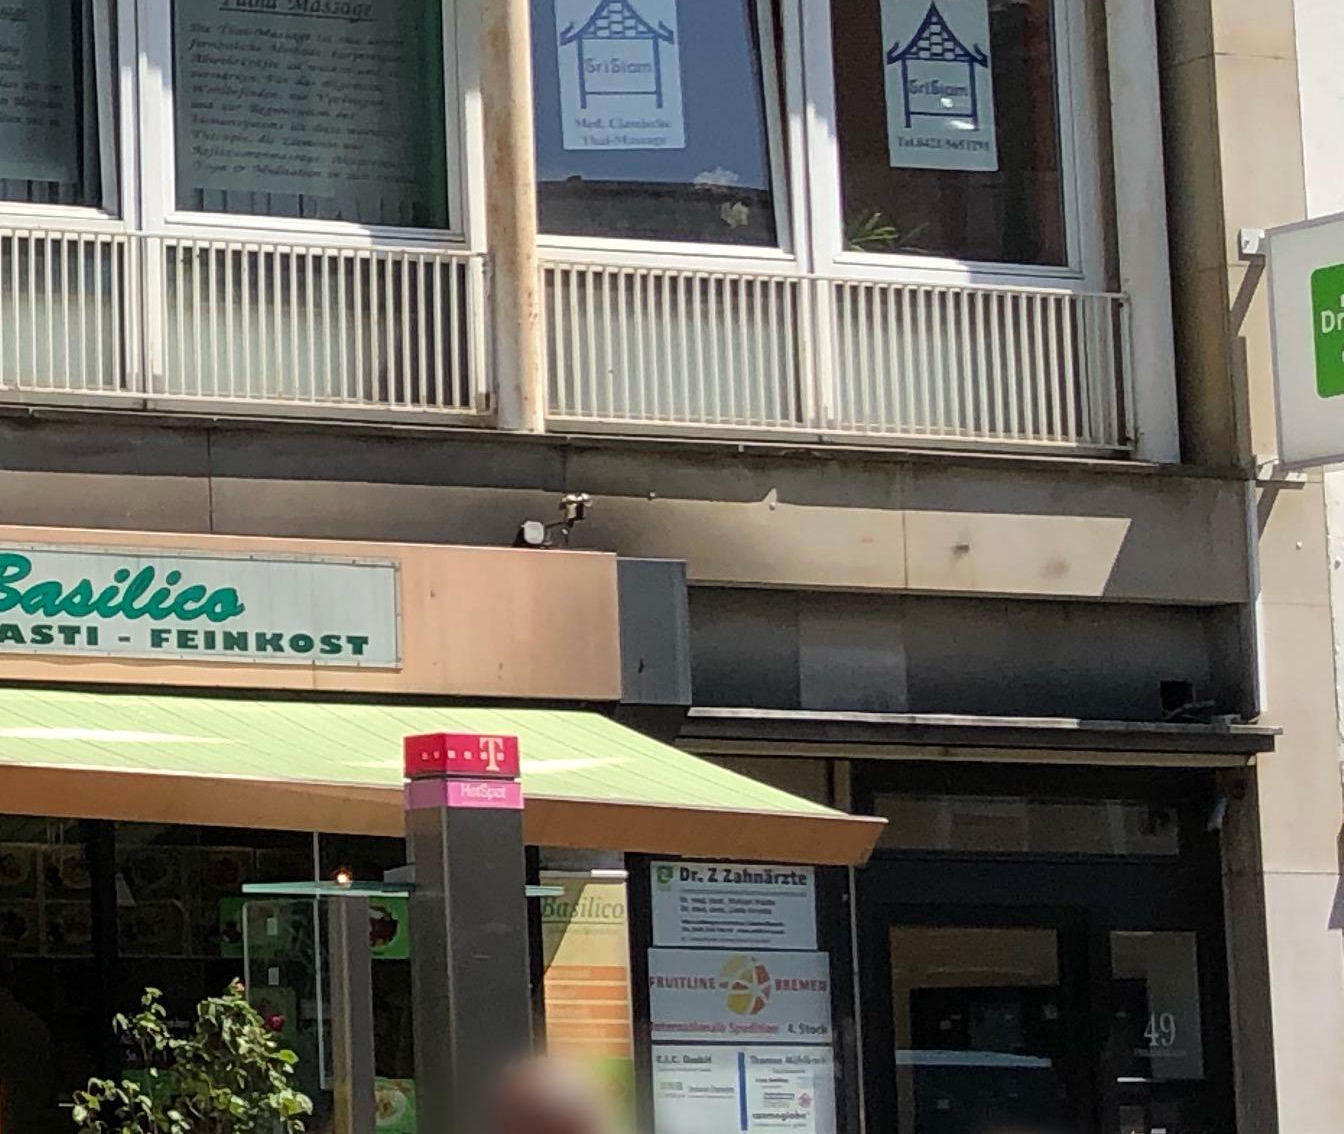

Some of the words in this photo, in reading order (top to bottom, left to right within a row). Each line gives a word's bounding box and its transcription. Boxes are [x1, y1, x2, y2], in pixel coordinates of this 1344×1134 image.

[150, 628, 371, 656] FEINKOST
[679, 867, 703, 882] Dr.
[707, 867, 719, 883] Z
[723, 868, 808, 885] Zahnärzte
[649, 975, 716, 990] FRUITLINE
[775, 978, 827, 991] BREMEN
[799, 1023, 828, 1034] Stock
[1143, 1011, 1177, 1047] 49
